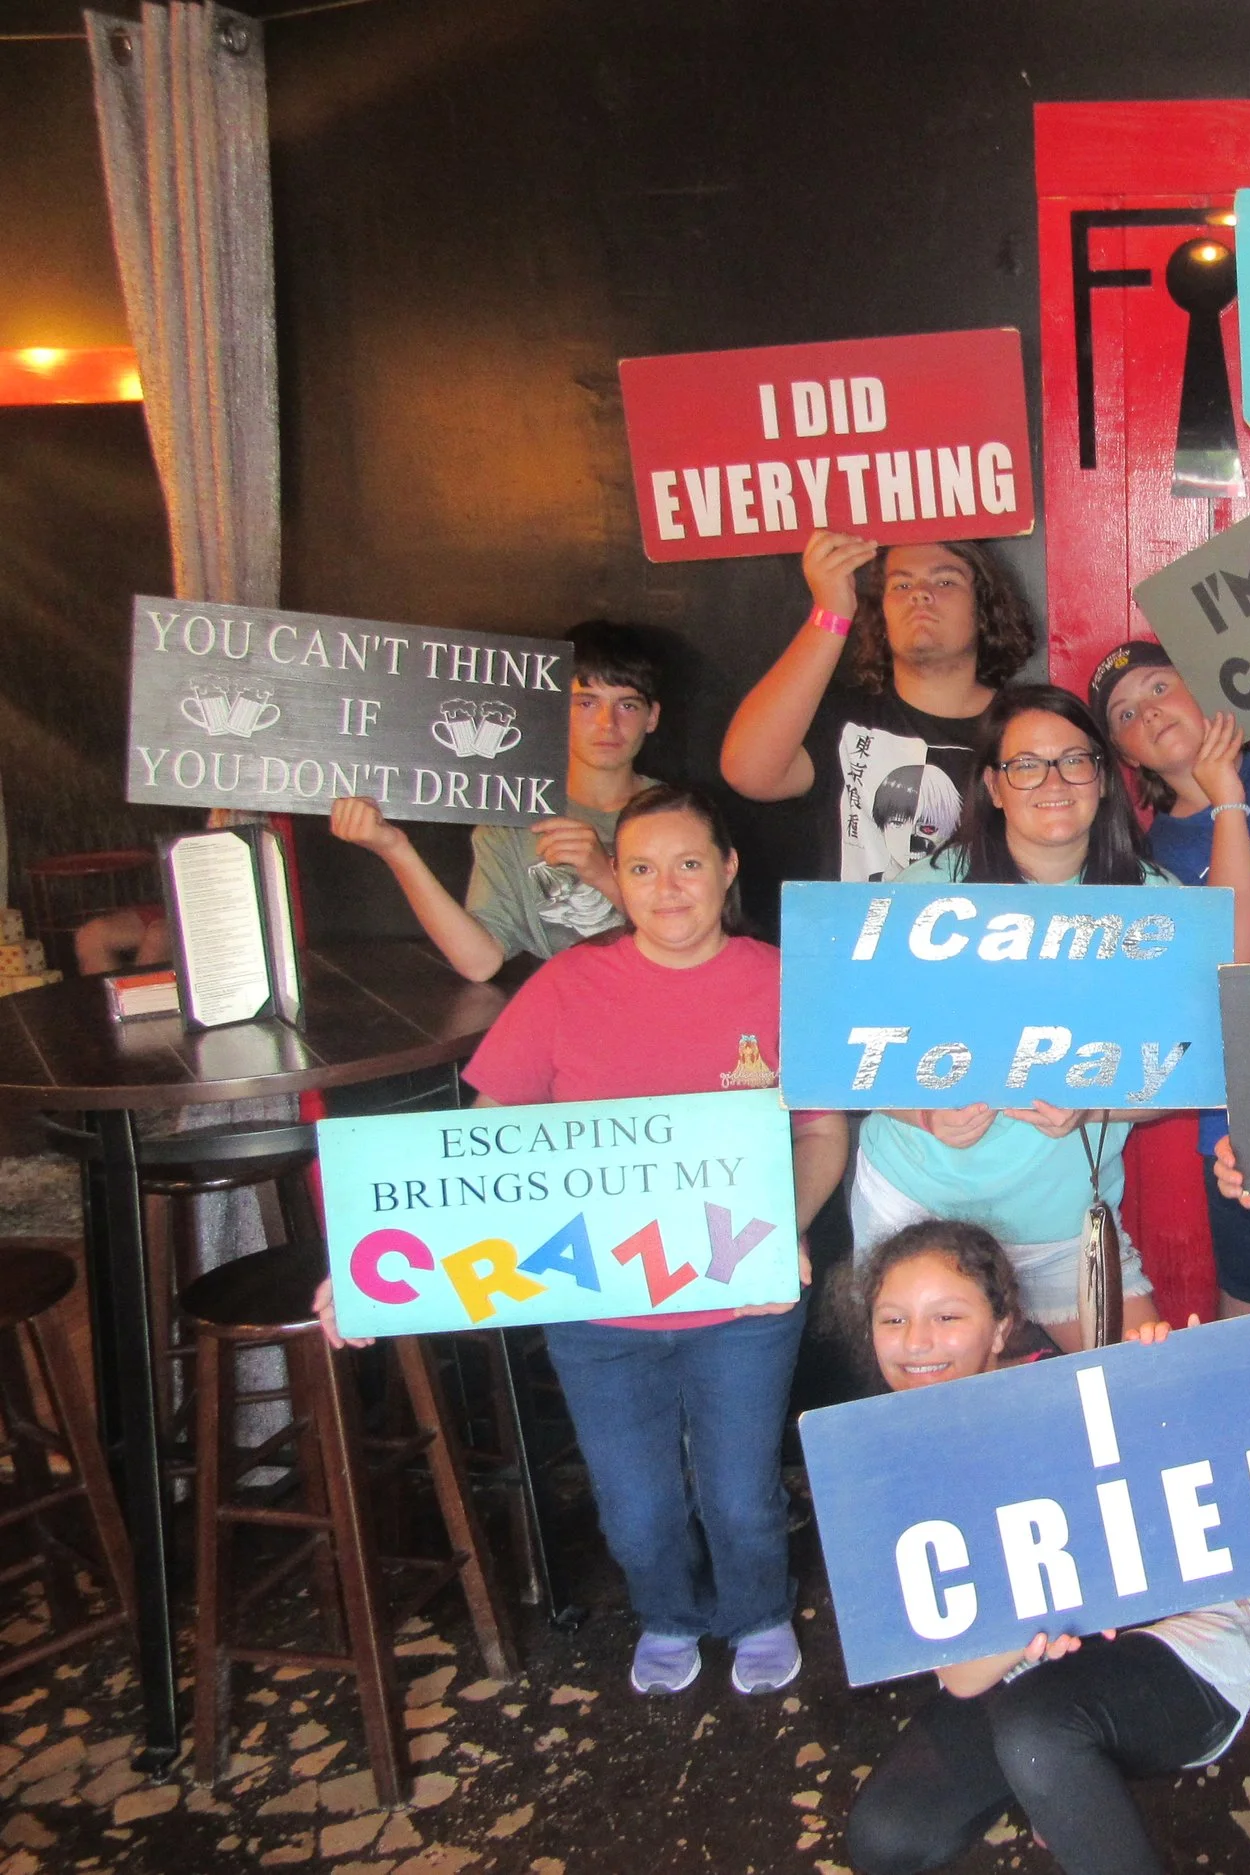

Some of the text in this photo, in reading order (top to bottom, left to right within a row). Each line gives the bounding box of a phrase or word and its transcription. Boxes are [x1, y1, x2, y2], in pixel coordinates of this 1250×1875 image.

[759, 376, 887, 440] I DID
[651, 442, 1017, 541] EVERYTHING
[148, 611, 563, 692] YOU CAN'T THINK
[338, 697, 381, 737] IF
[137, 746, 557, 816] YOU DON'T DRINK
[851, 896, 1175, 962] I Came
[847, 1025, 1192, 1103] To Pay
[439, 1113, 674, 1159] ESCAPING
[371, 1156, 747, 1213] BRINGS OUT MY
[349, 1200, 778, 1325] CRAZY
[1076, 1365, 1121, 1468] I
